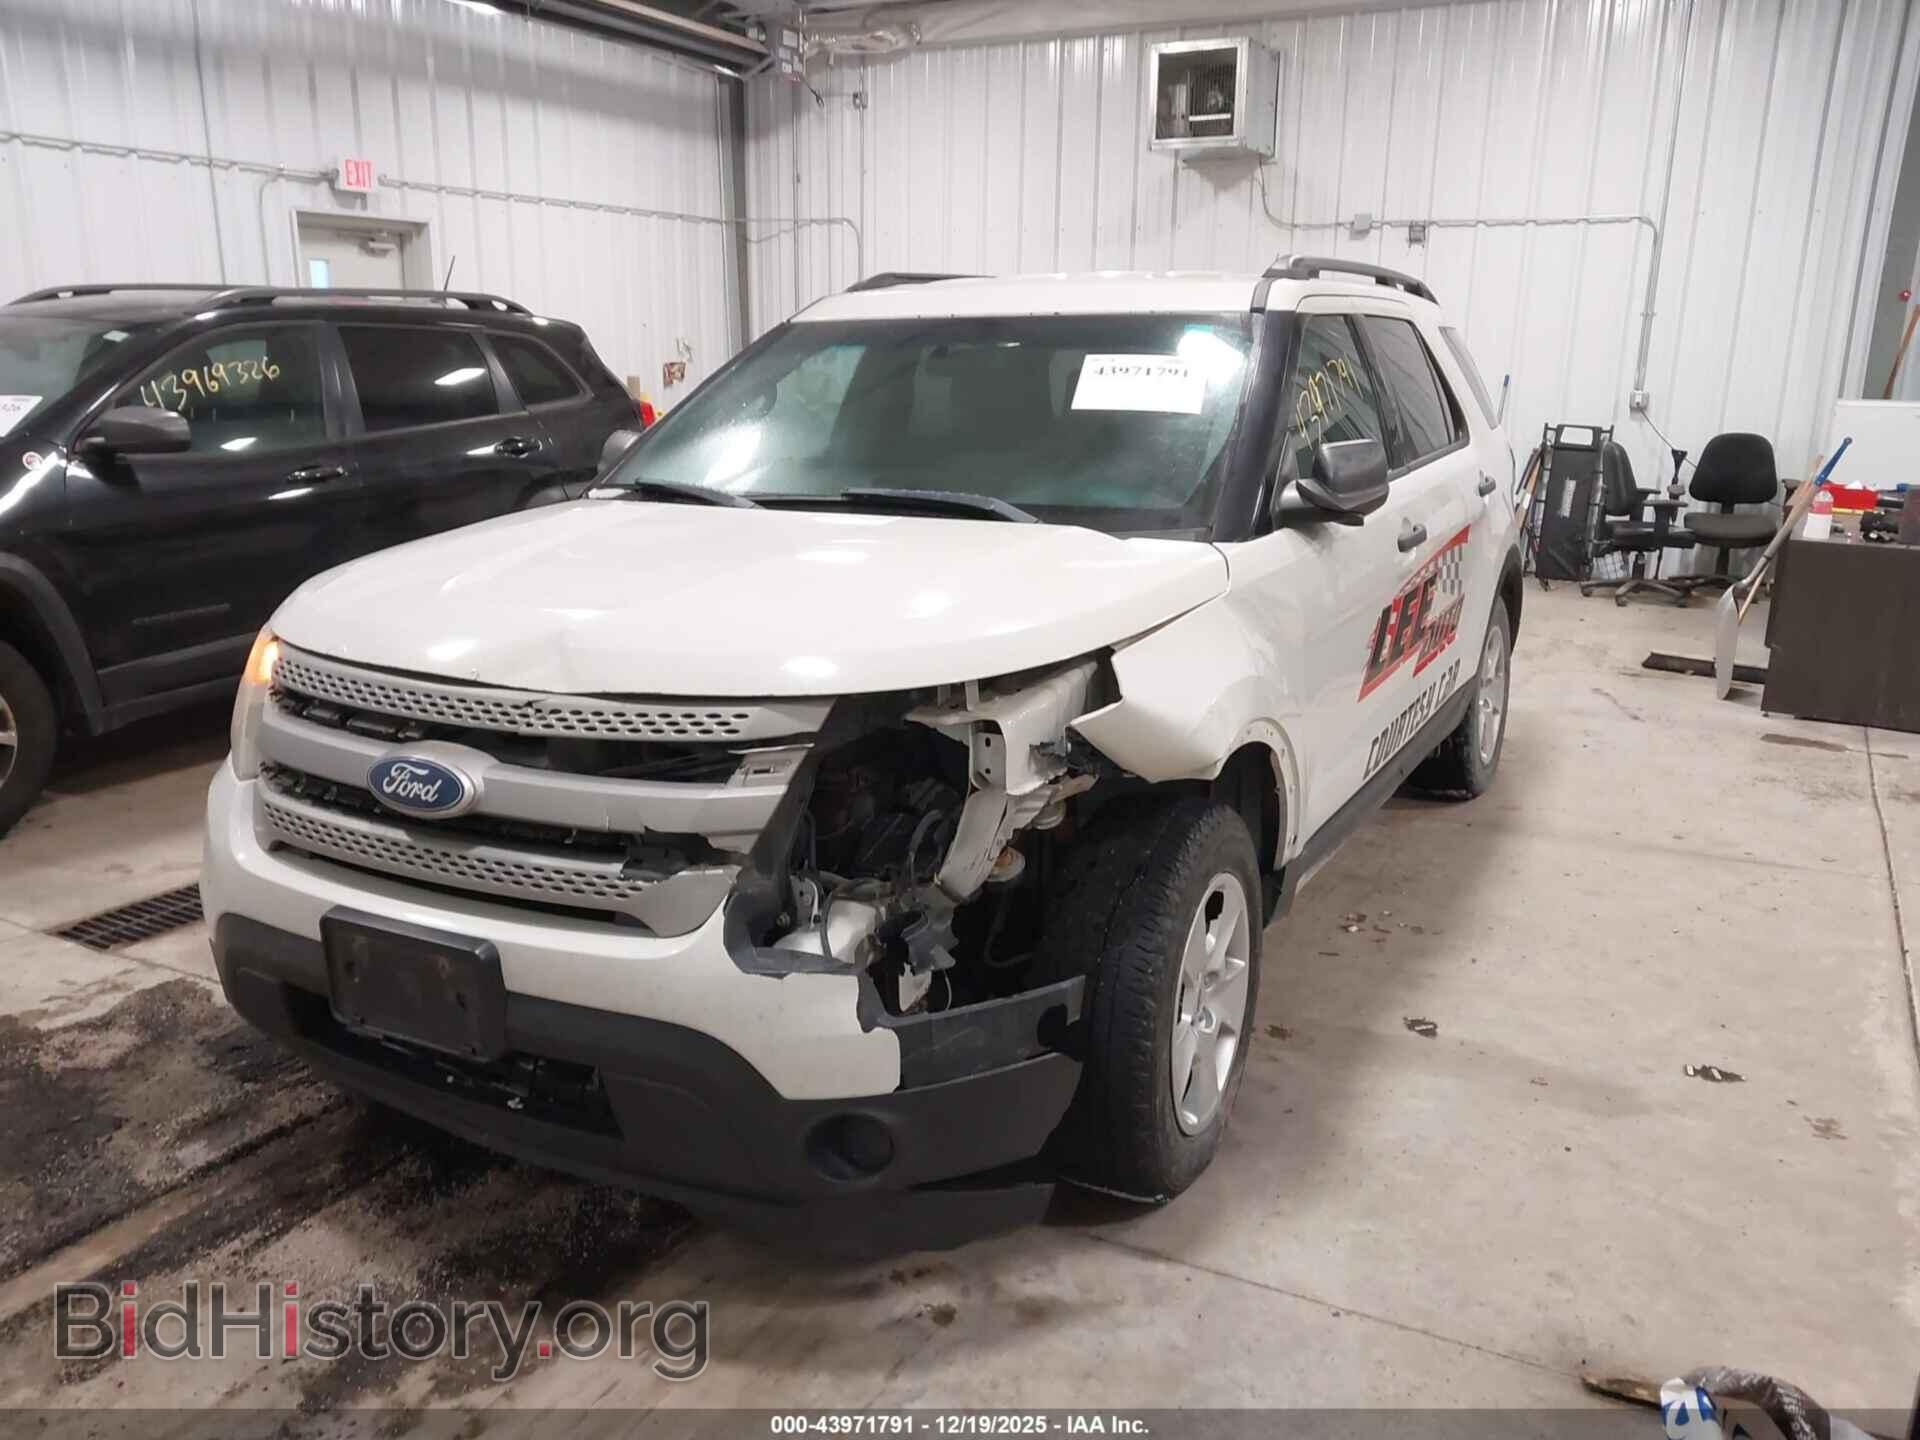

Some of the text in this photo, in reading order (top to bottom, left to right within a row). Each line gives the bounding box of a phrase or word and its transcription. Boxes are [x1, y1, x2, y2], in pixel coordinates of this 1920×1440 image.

[344, 159, 372, 188] EXIT
[140, 356, 280, 411] 43969326
[1363, 573, 1438, 682] LEE
[1363, 681, 1438, 781] COURTESY
[382, 762, 442, 803] Ford
